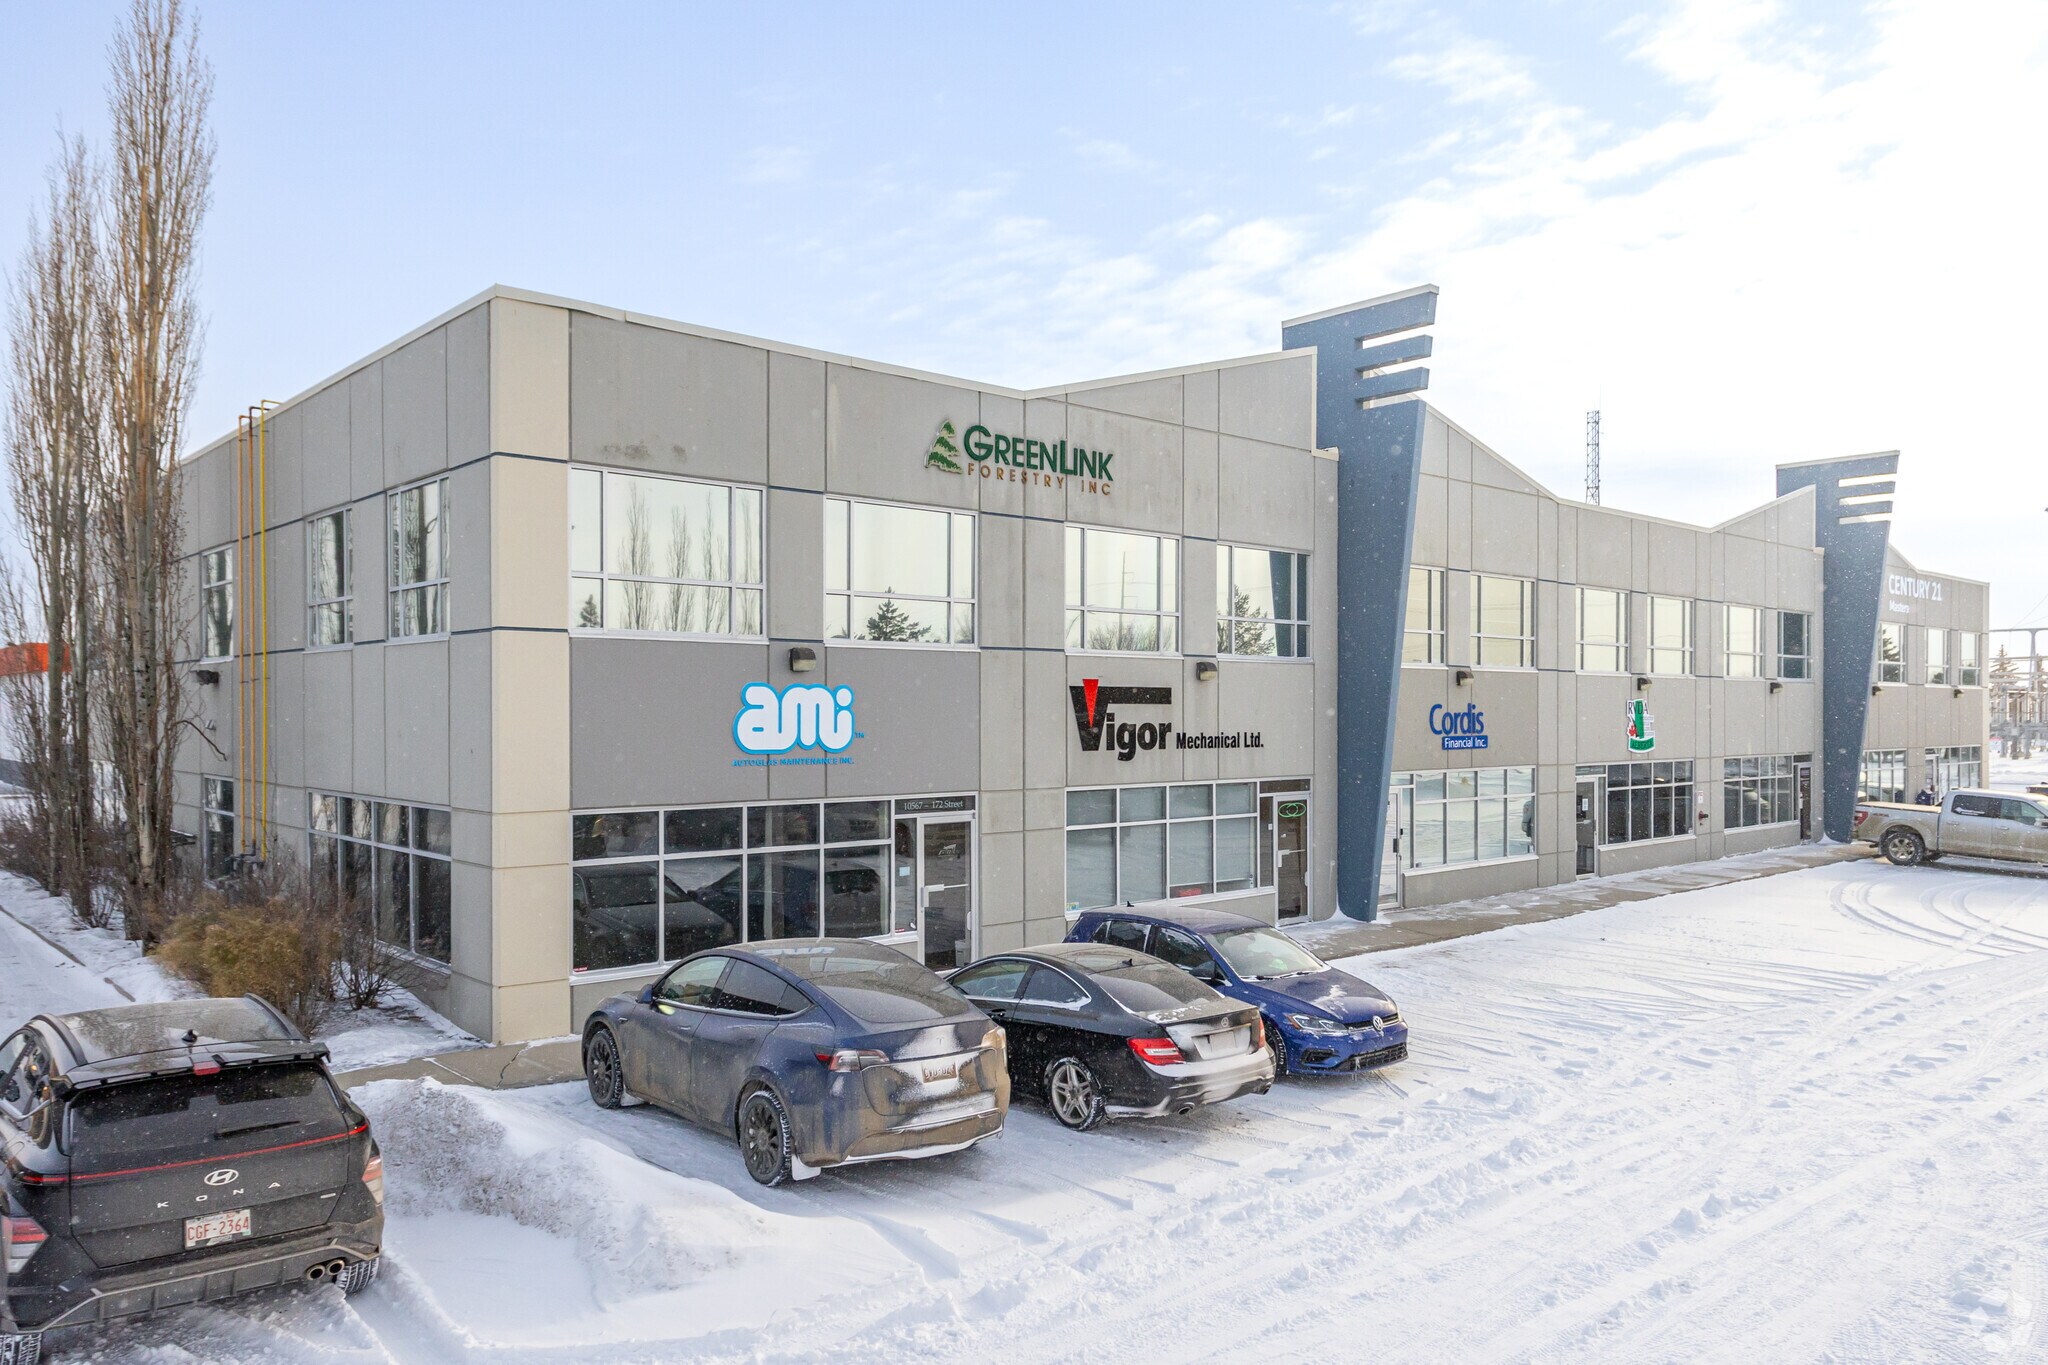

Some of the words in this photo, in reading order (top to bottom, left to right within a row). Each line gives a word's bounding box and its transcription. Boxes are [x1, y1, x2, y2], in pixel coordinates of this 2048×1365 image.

[967, 462, 1065, 489] FORESTRY
[1081, 479, 1111, 496] INC
[1889, 575, 1930, 598] CENTURY
[1931, 582, 1942, 601] 21
[733, 682, 855, 754] ami
[1069, 679, 1172, 762] Vigor
[1176, 731, 1241, 750] Mechanical
[1243, 731, 1264, 749] Ltd.
[1429, 702, 1485, 735] Cordis
[1444, 737, 1473, 749] Financial
[780, 757, 838, 766] MAINTENANCE
[904, 801, 923, 811] 10567
[932, 800, 944, 809] 172
[945, 800, 963, 809] Street
[156, 1180, 282, 1209] KONA
[187, 1216, 249, 1241] CGF-2364
